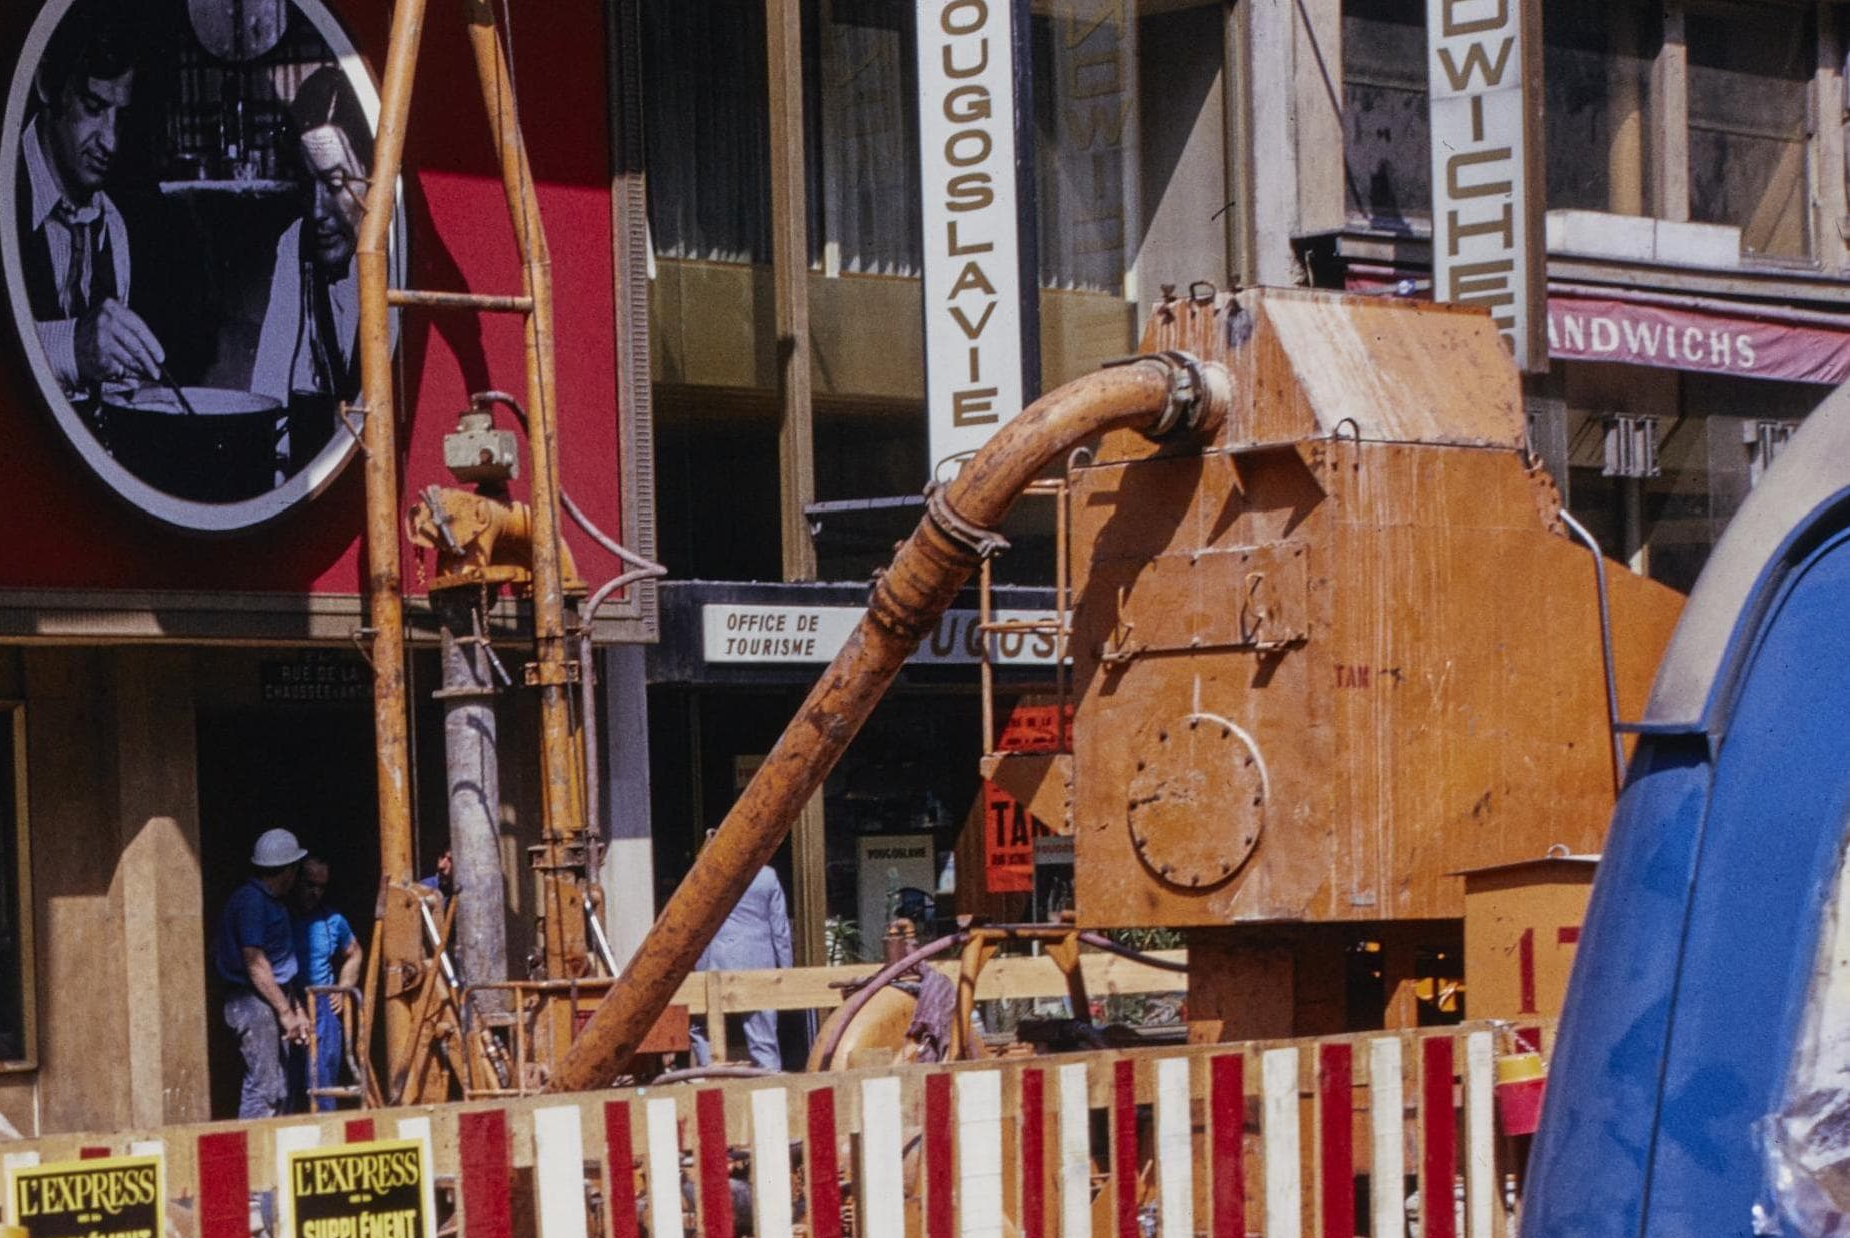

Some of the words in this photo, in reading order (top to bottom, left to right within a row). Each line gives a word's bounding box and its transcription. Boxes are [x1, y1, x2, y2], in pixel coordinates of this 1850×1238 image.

[726, 613, 786, 632] OFFICE
[796, 614, 819, 632] DE
[726, 637, 816, 656] TOURISME
[293, 1150, 420, 1197] L'EXPRESS
[18, 1168, 156, 1217] L'EXPRESS
